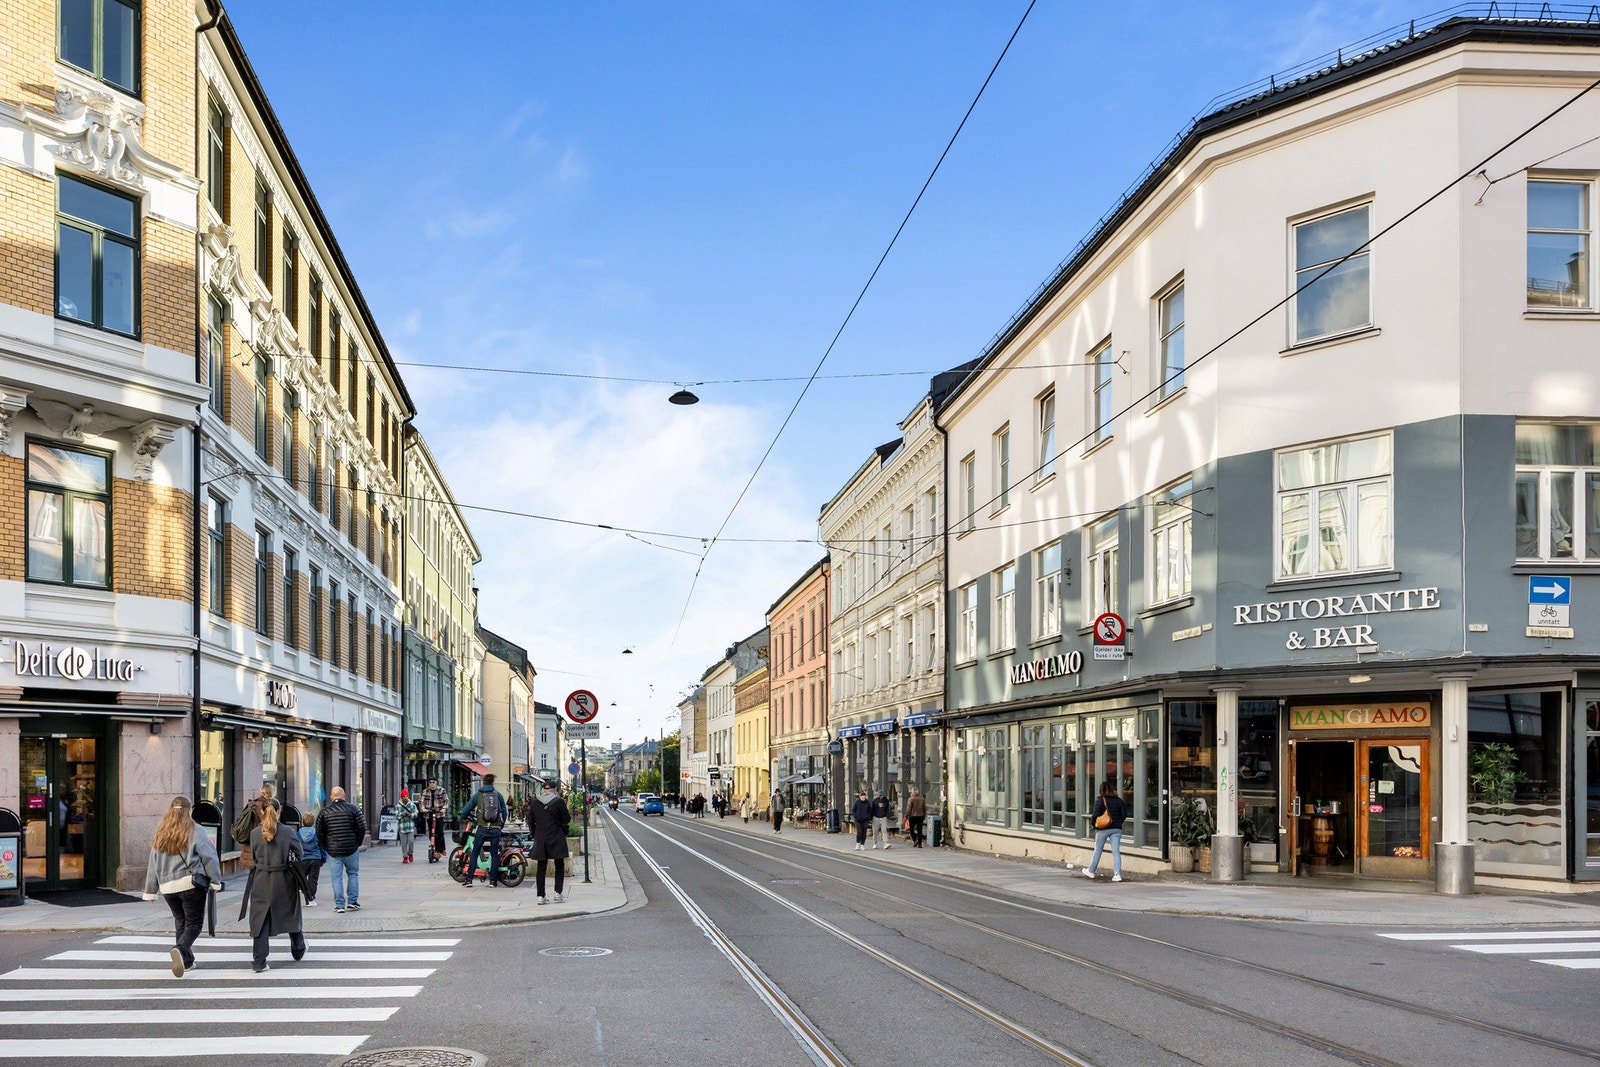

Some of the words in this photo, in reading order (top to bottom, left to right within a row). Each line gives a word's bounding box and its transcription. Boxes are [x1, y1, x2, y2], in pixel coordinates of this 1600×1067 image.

[1233, 587, 1441, 625] RISTORANTE
[1285, 631, 1307, 650] &
[1312, 624, 1378, 648] BAR
[15, 640, 53, 677] Deli
[64, 646, 86, 680] de
[95, 646, 134, 681] Luca
[1010, 650, 1083, 685] MANGIAMO
[1293, 706, 1428, 726] MANGIAMO
